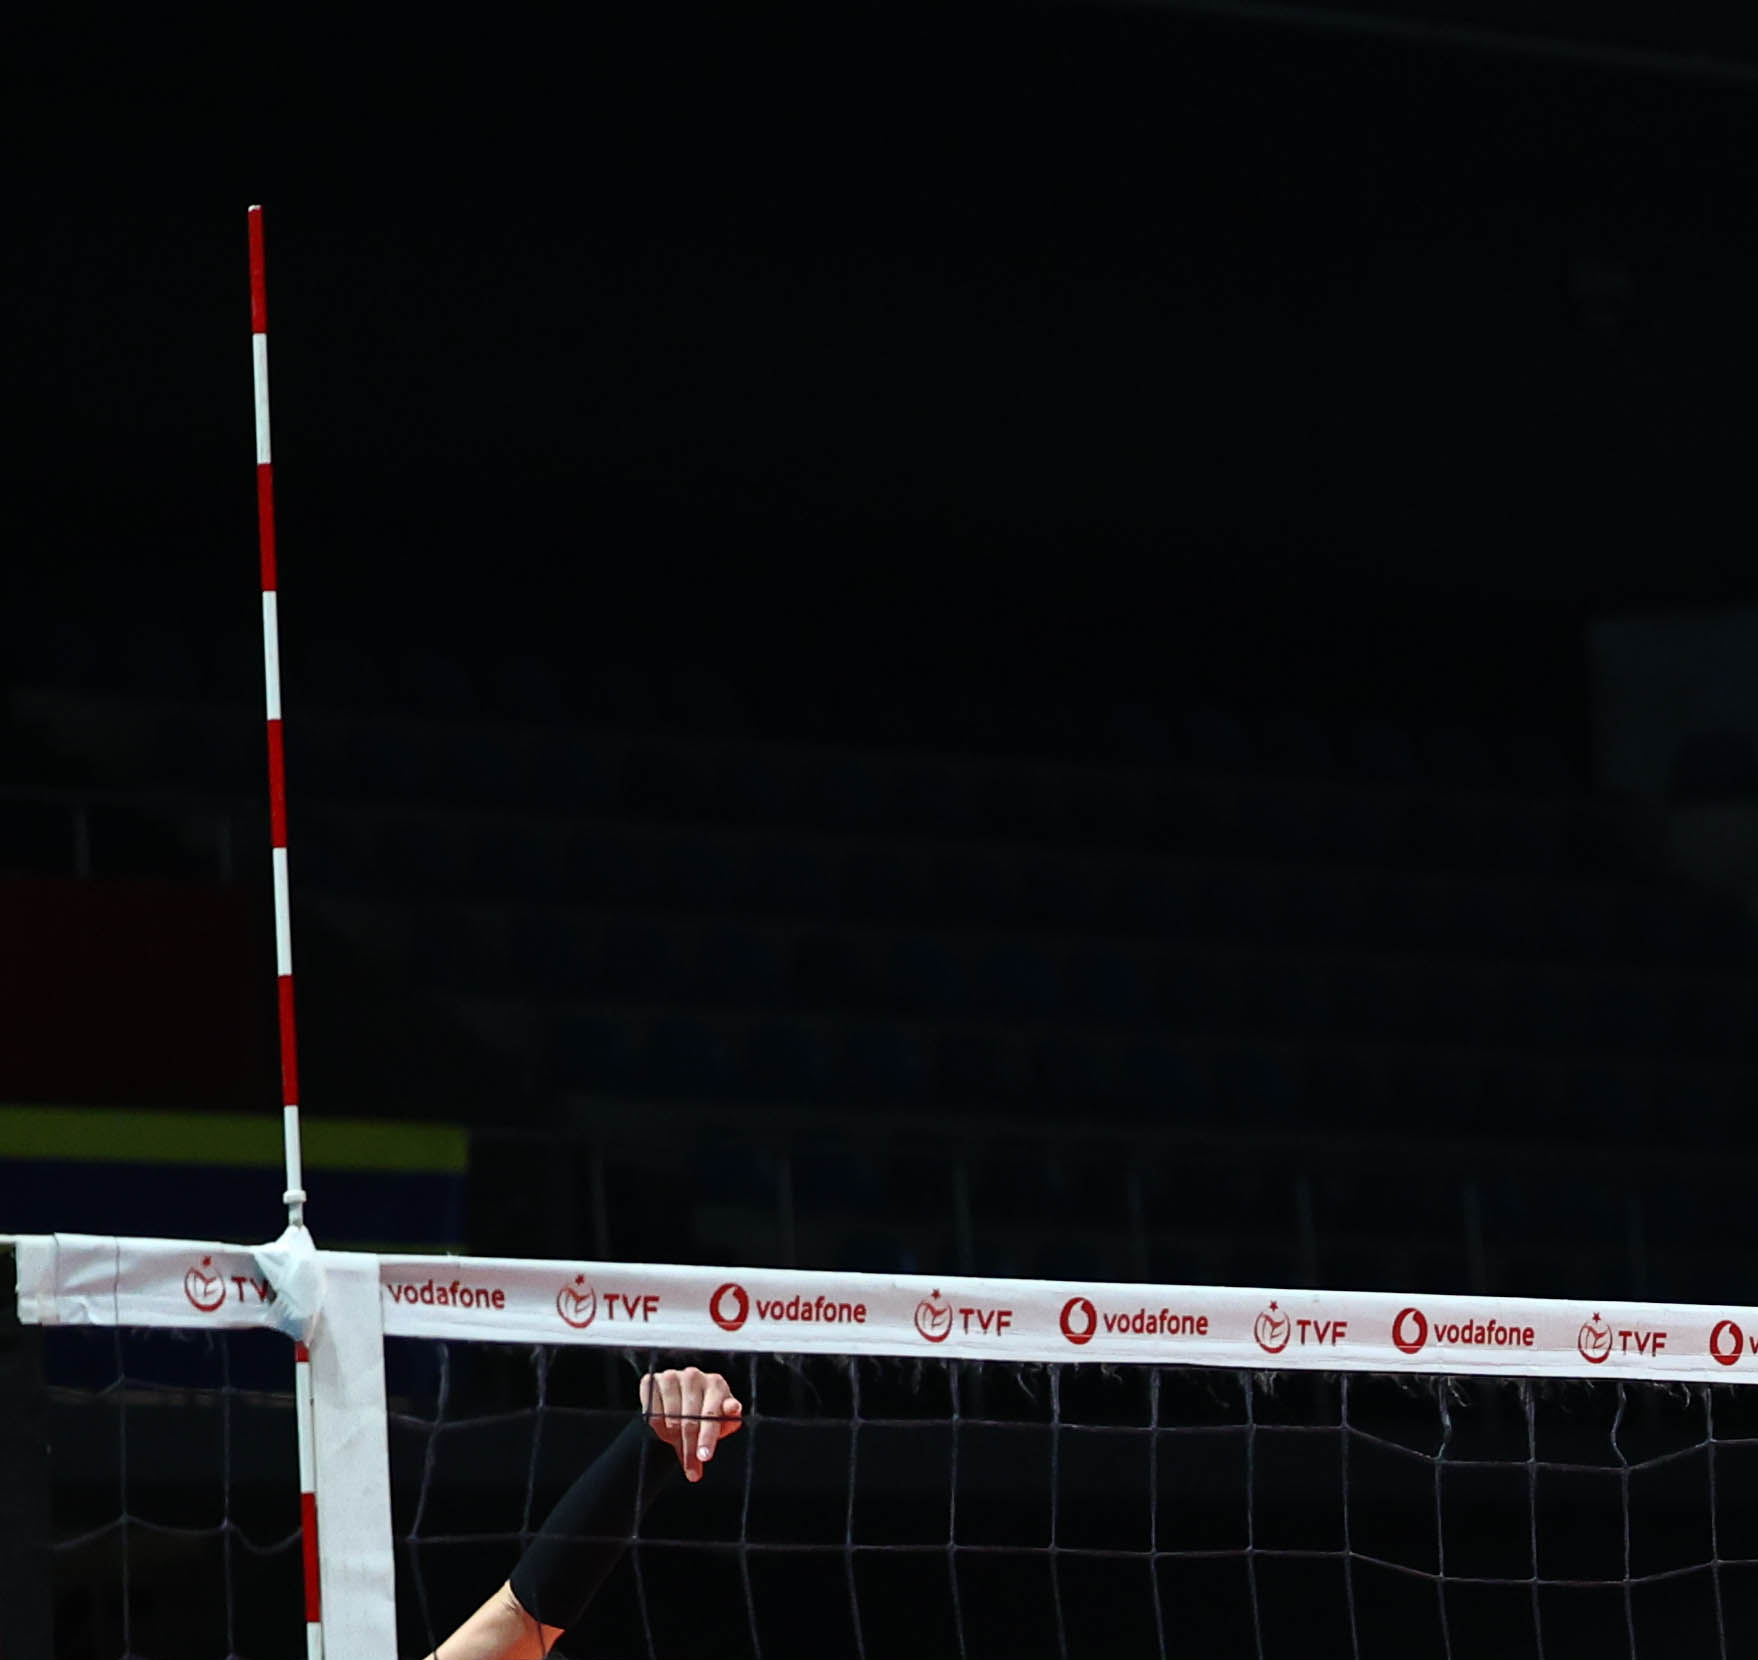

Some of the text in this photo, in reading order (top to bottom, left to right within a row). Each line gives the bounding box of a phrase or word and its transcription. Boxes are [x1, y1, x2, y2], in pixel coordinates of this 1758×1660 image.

[387, 1279, 505, 1309] vodafone
[603, 1293, 661, 1320] TVF
[755, 1296, 867, 1323] vodafone
[958, 1308, 1013, 1331] TVF
[1104, 1308, 1209, 1336] vodafone
[1296, 1320, 1348, 1344] TVF
[1436, 1320, 1536, 1347] vodafone
[1619, 1330, 1668, 1352] TVF
